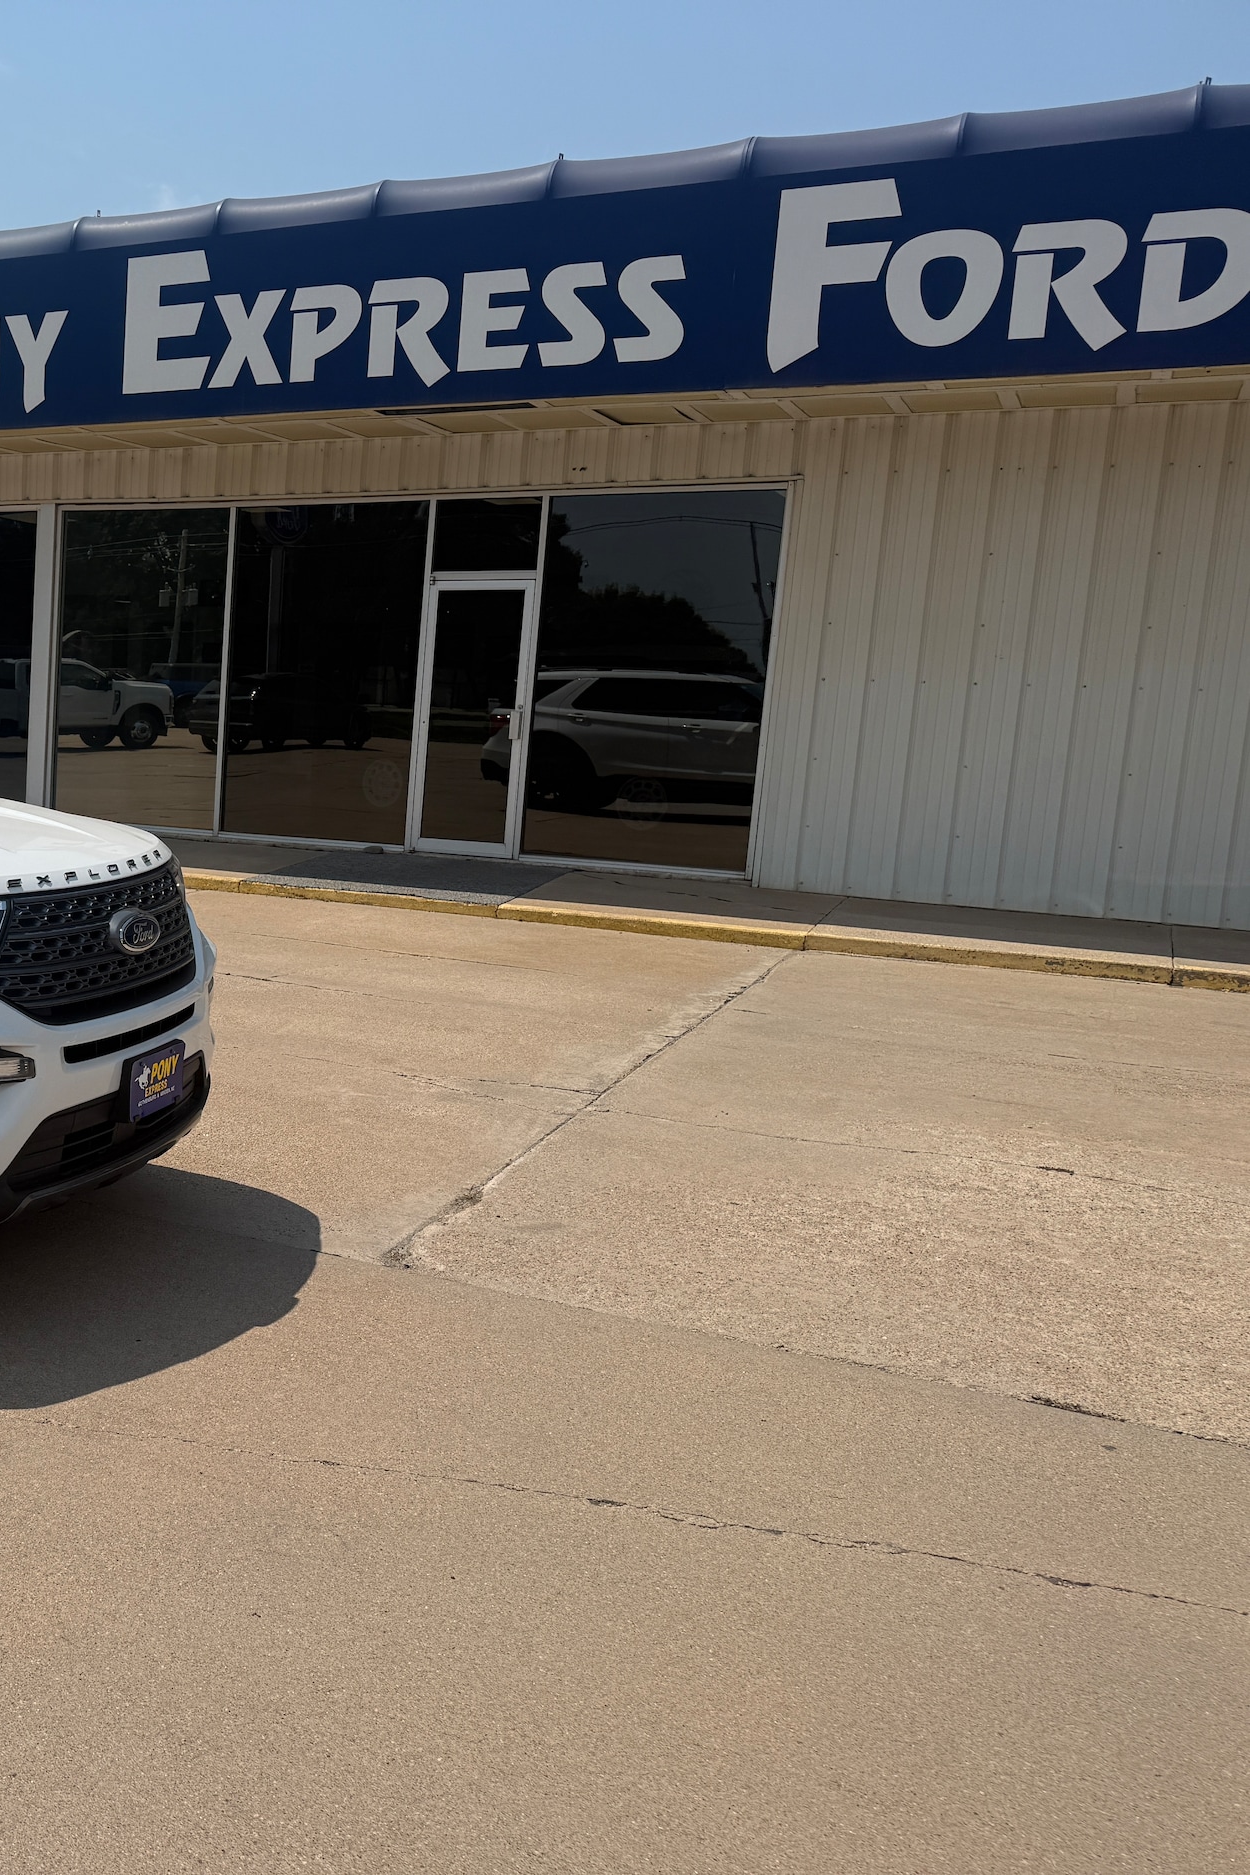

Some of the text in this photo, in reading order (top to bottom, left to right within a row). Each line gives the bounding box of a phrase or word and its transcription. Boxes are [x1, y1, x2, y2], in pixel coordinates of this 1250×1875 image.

[122, 250, 687, 395] EXPRESS
[766, 178, 1250, 373] FORD
[6, 849, 162, 891] EXPLORER
[133, 922, 154, 944] Ford
[150, 1054, 180, 1084] PONY
[144, 1079, 168, 1098] EXPRESS
